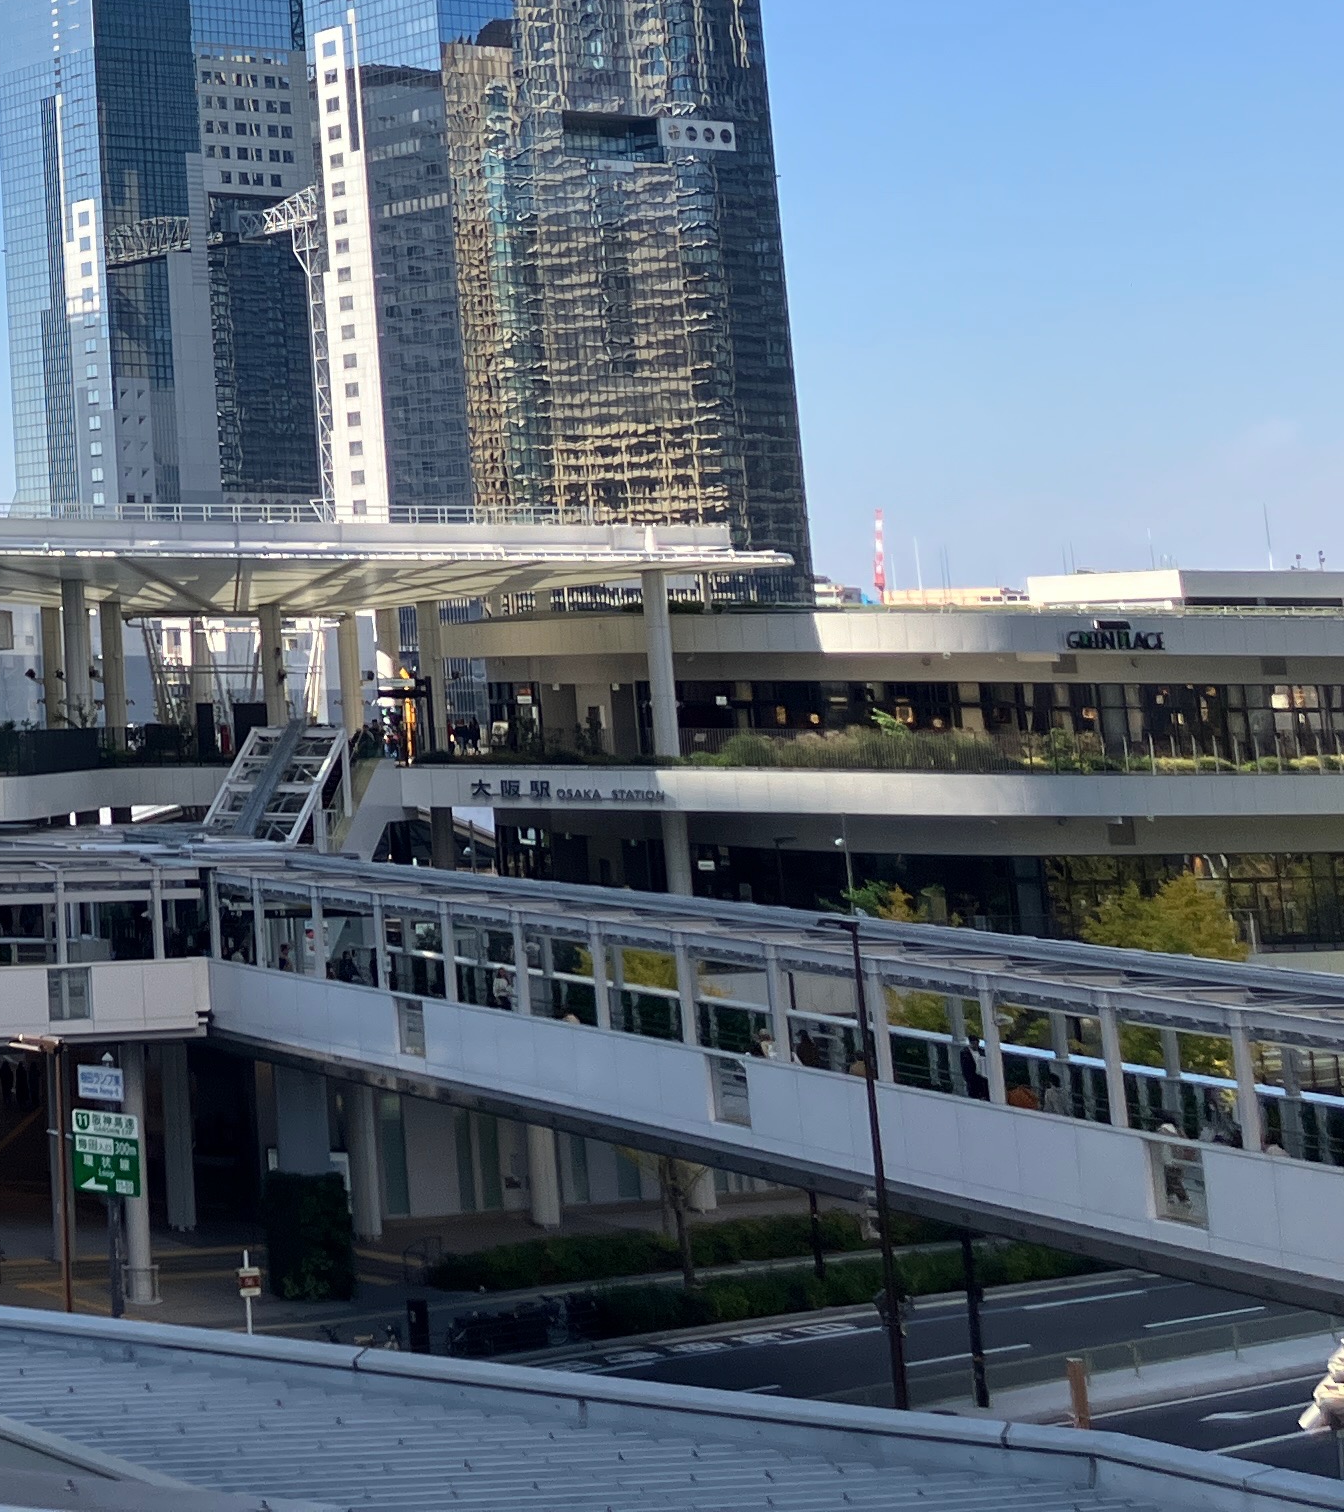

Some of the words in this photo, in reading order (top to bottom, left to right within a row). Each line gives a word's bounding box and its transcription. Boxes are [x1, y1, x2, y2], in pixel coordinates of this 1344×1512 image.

[471, 779, 551, 798] 大阪駅
[556, 788, 602, 801] OSAKA
[611, 789, 665, 802] STATION
[77, 1113, 89, 1127] 11
[98, 1168, 116, 1179] Loop
